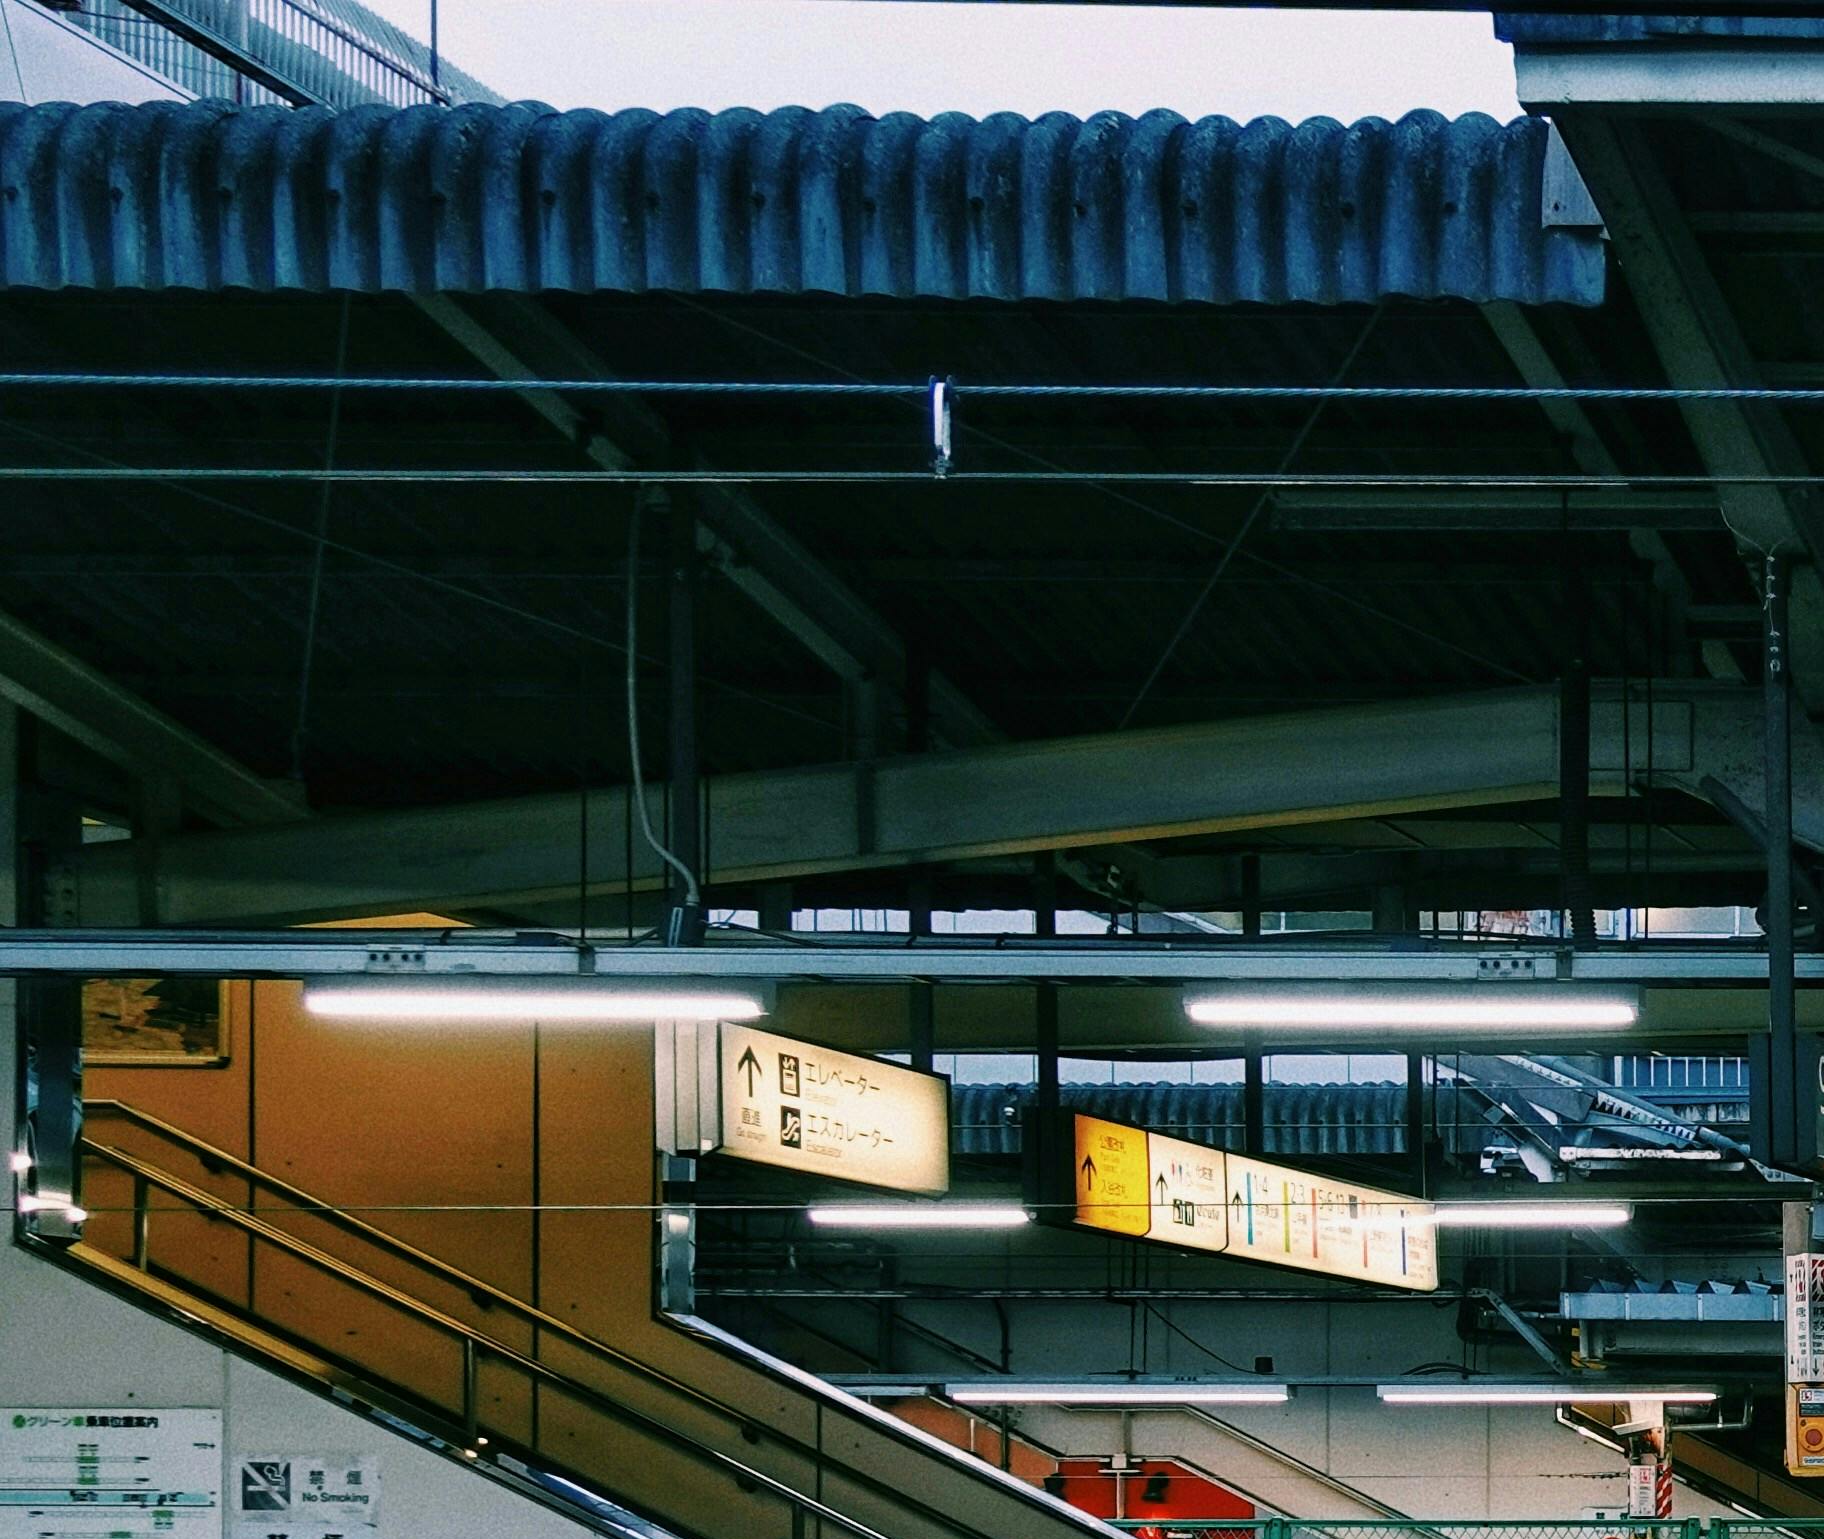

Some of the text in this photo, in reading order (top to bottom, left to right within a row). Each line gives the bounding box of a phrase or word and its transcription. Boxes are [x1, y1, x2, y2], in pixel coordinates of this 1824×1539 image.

[805, 1062, 881, 1096] エレベーター
[807, 1114, 894, 1148] エスカレーター
[303, 1491, 370, 1505] No Smoking
